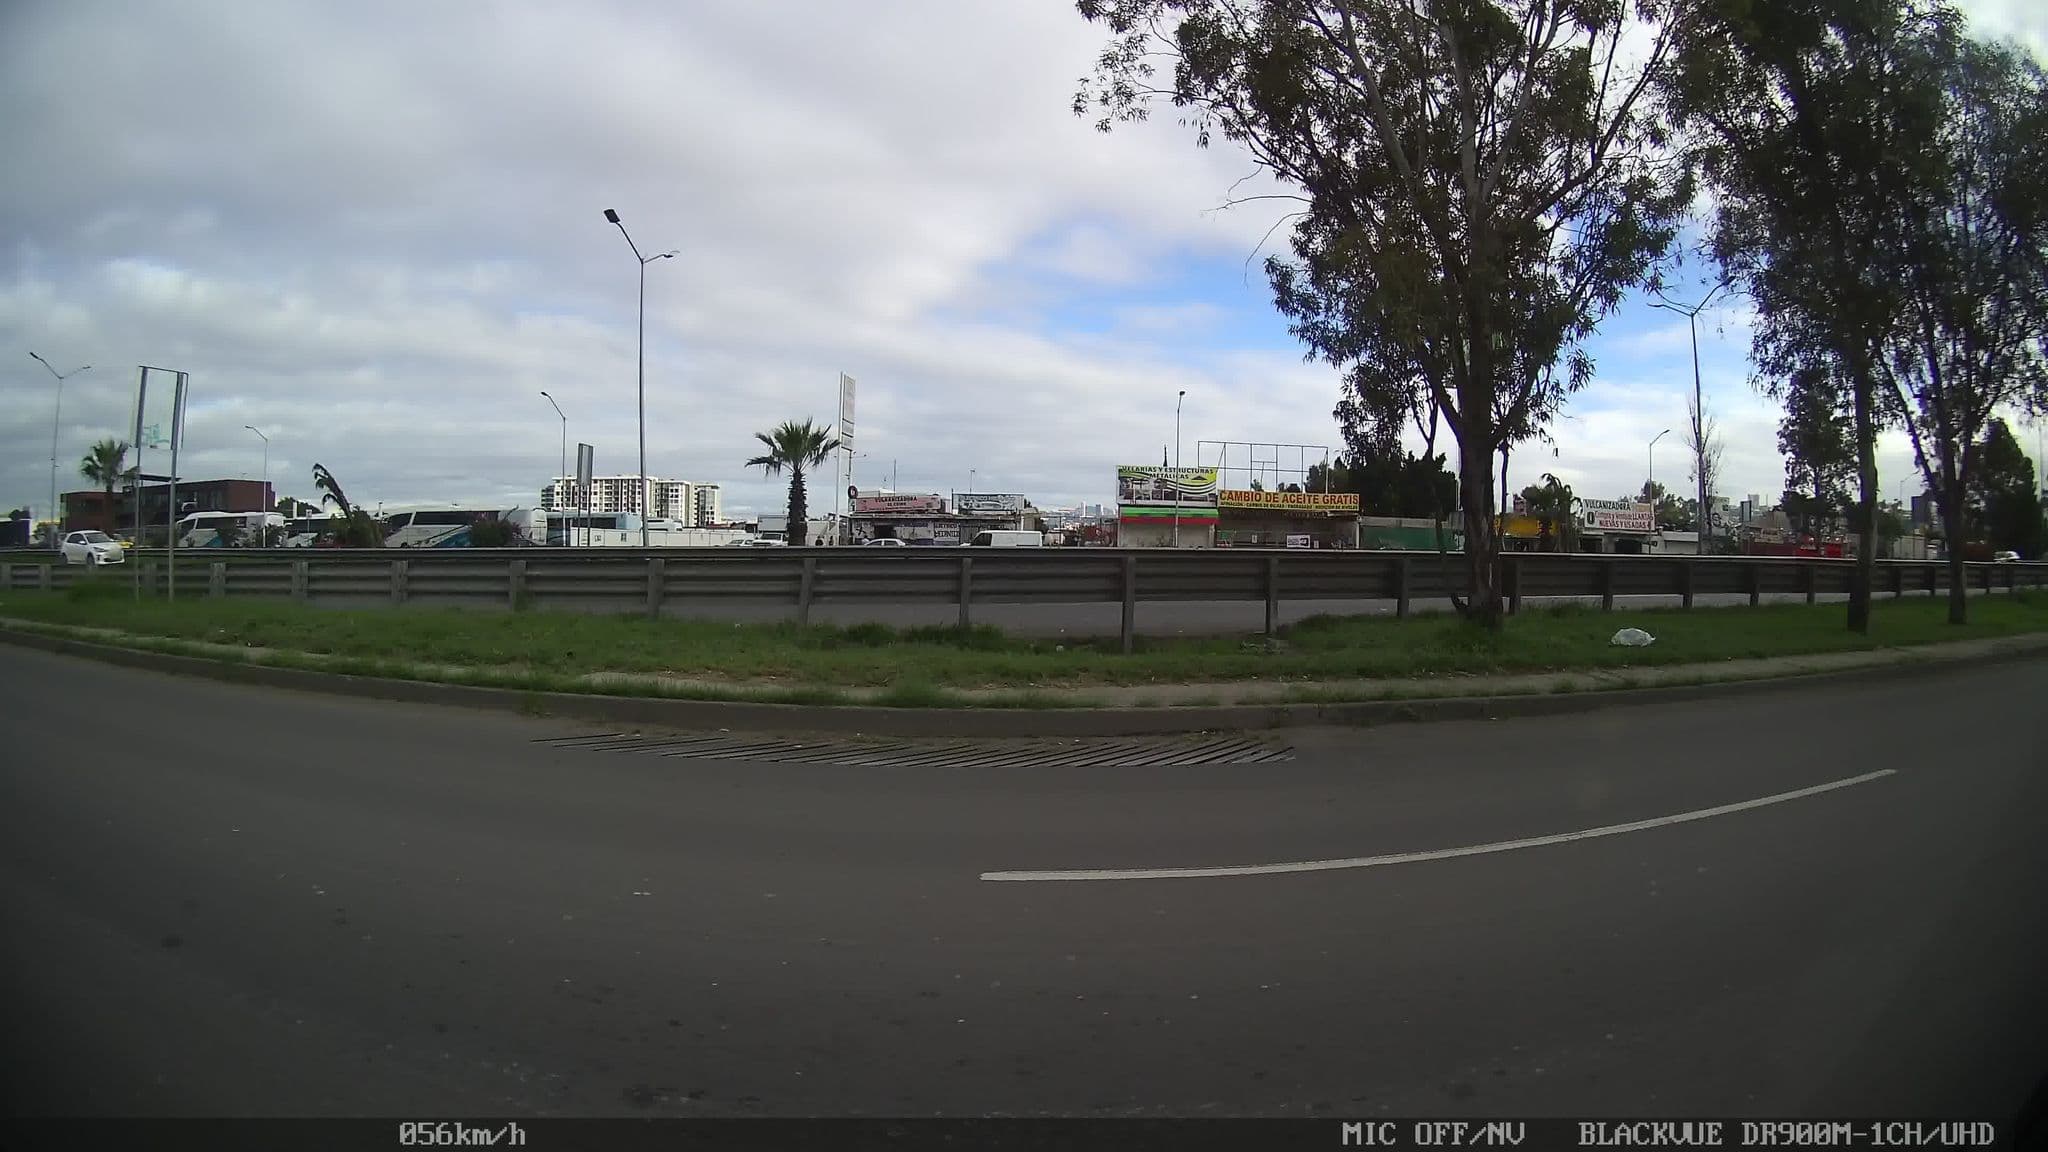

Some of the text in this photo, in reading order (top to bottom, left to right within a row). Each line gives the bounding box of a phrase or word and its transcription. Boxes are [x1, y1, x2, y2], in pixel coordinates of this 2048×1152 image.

[1219, 491, 1358, 505] CAMBIO DE ACEITE GRATIS
[1585, 499, 1631, 511] VULCANIZADORA
